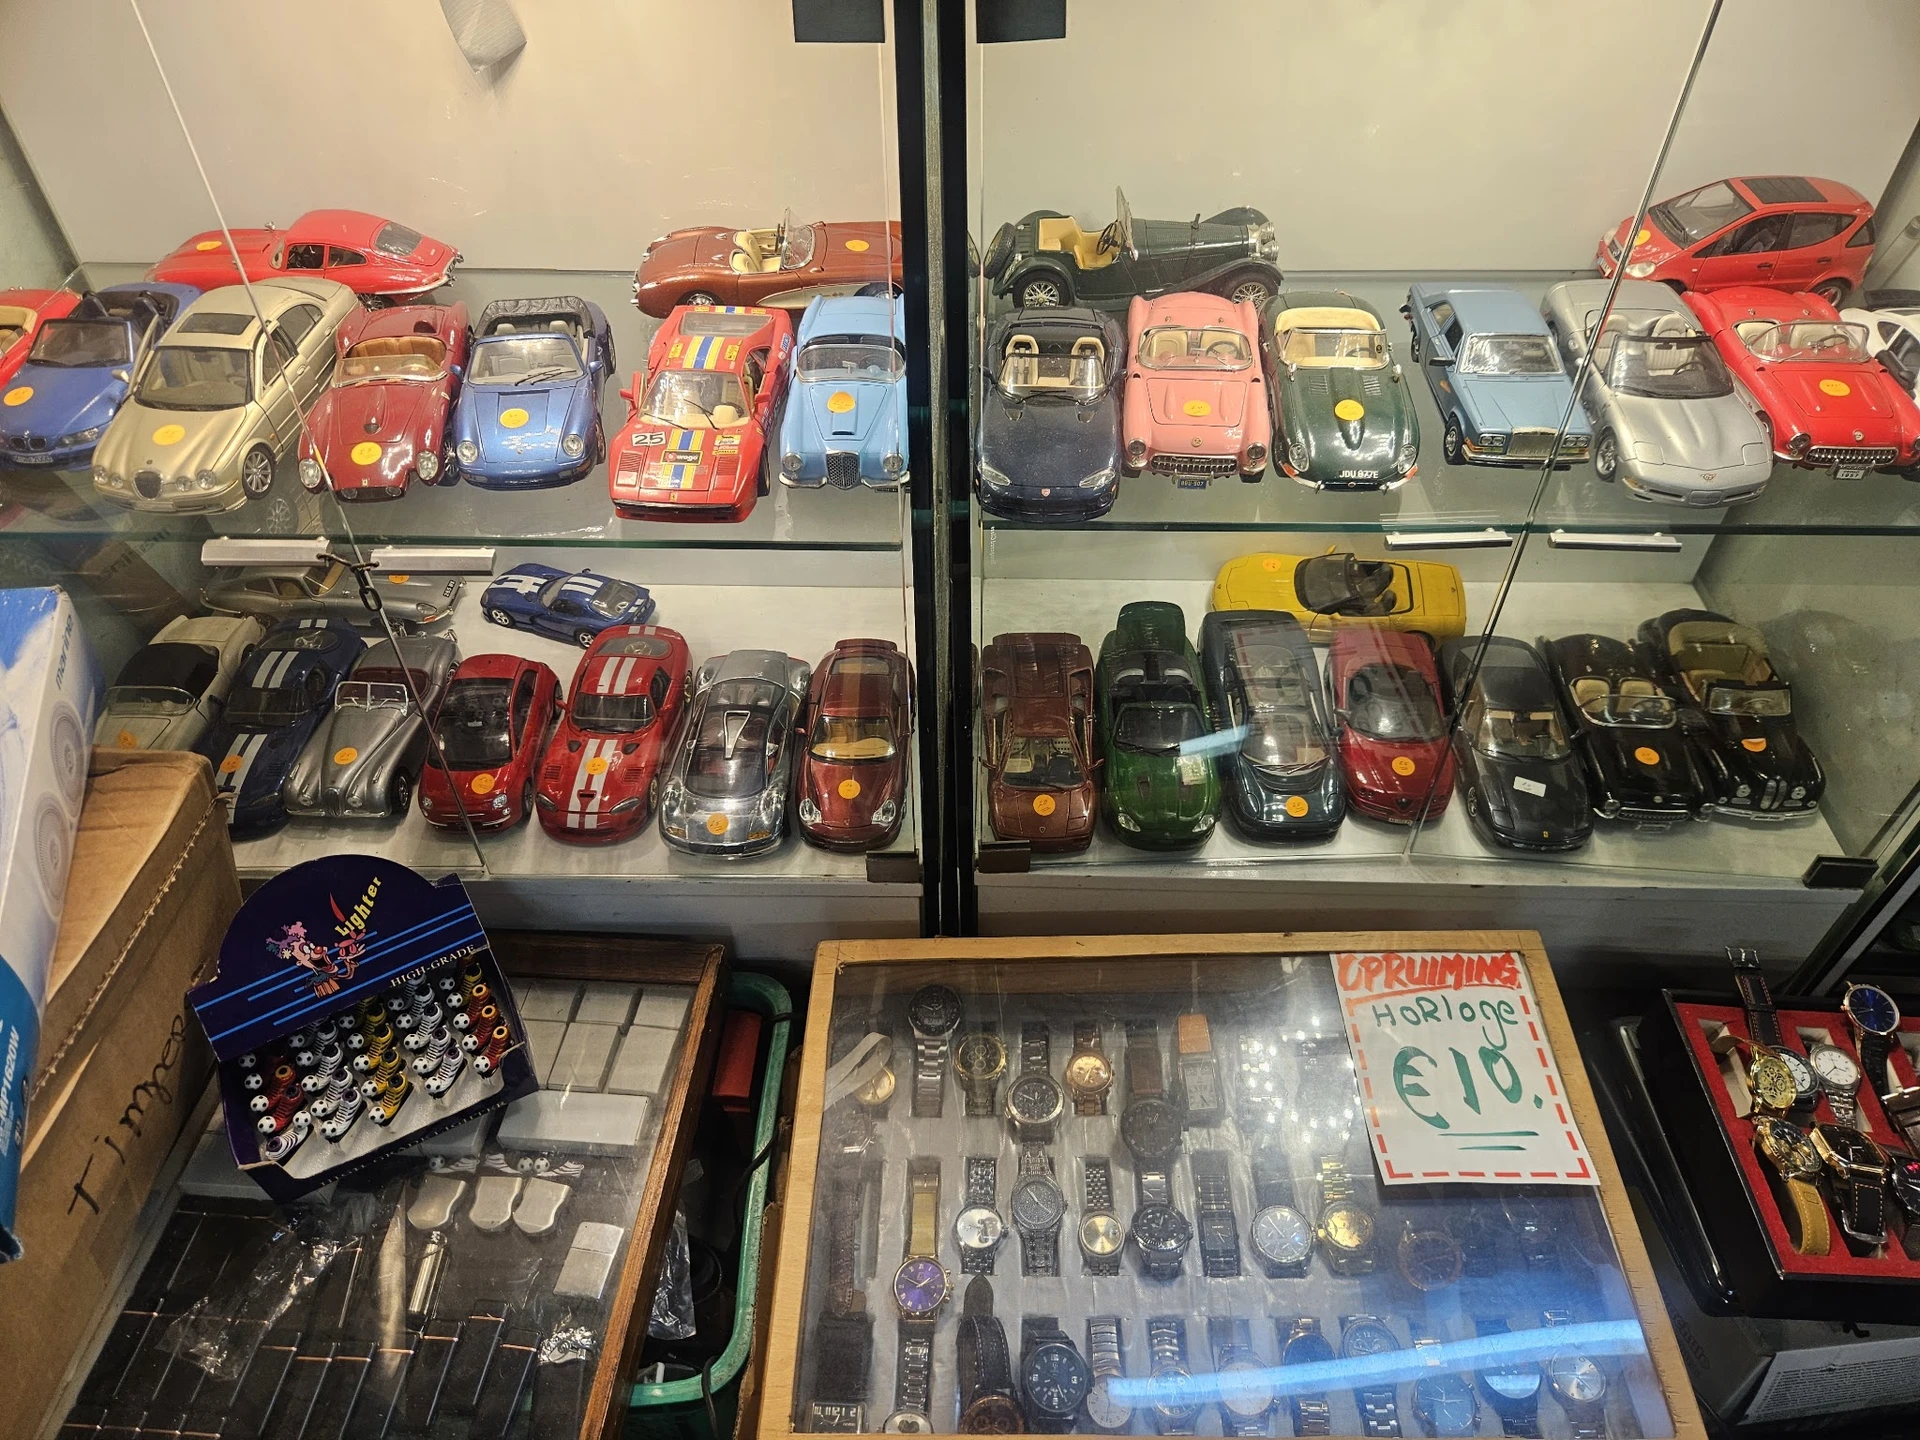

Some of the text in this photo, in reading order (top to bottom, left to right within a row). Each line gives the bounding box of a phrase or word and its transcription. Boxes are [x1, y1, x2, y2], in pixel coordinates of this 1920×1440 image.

[634, 433, 664, 445] 25
[1339, 469, 1357, 478] JDU
[56, 613, 73, 690] marine
[335, 876, 382, 936] Lighter
[390, 944, 476, 988] HIGH-GRADE
